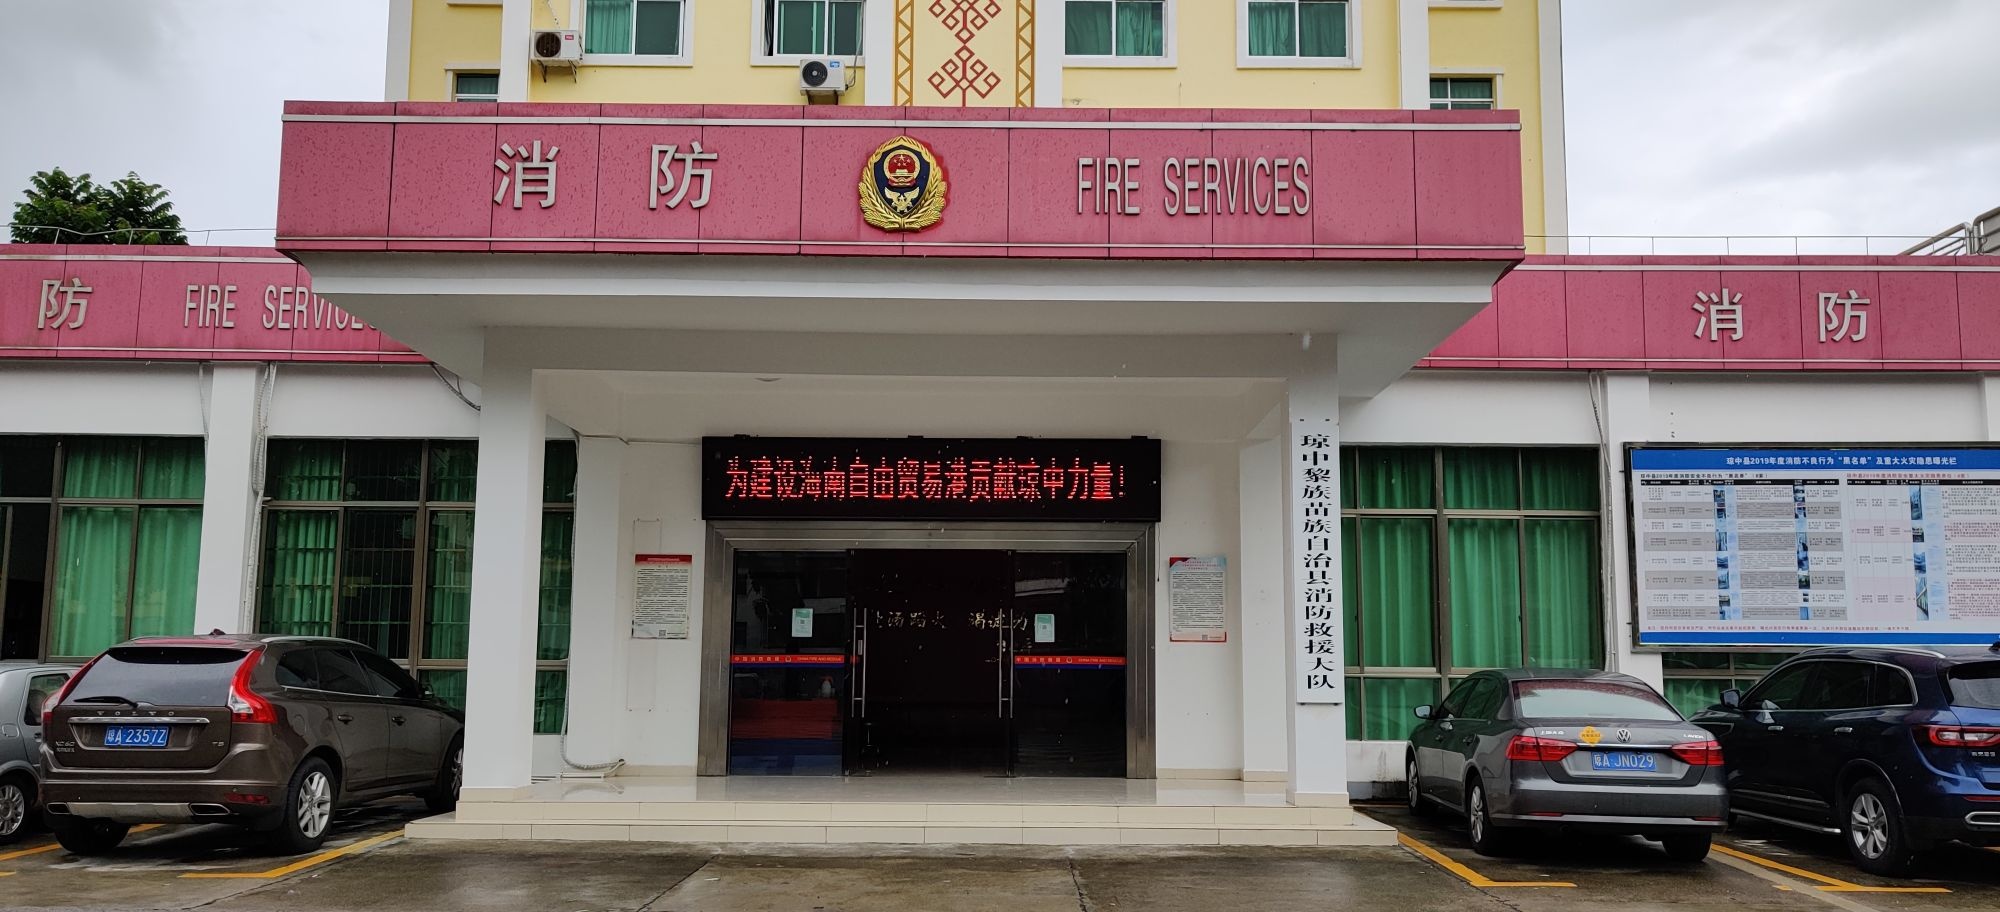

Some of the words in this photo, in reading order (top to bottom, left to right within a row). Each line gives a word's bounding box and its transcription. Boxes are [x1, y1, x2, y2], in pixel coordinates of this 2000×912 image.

[494, 140, 719, 210] 消防
[1077, 156, 1141, 214] FIRE
[1164, 156, 1312, 216] SERVICES
[37, 278, 93, 330] 防
[184, 284, 238, 328] FIRE
[262, 284, 377, 329] SERVI
[1692, 287, 1871, 343] 消防
[1300, 433, 1336, 690] 琼中黎族苗族自治县消防救援大队
